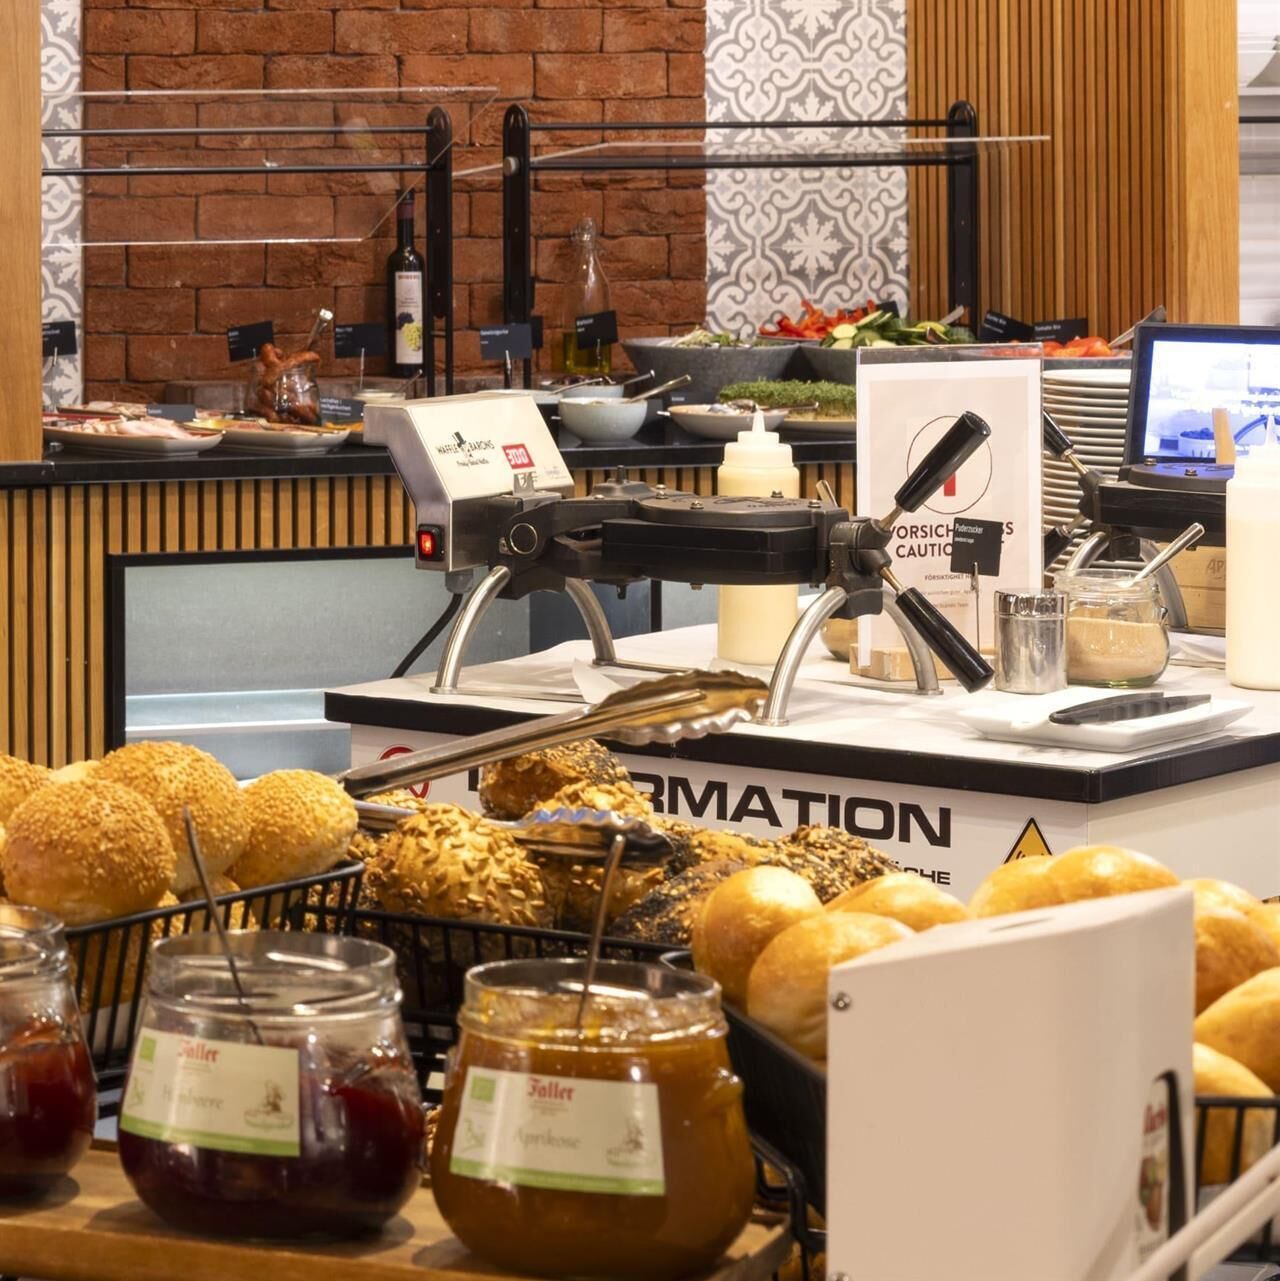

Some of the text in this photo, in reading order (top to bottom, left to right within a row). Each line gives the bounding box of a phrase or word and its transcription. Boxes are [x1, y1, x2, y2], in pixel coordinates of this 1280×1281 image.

[437, 440, 495, 455] WAFFLE BARONS
[890, 524, 954, 540] VORSICH
[954, 523, 984, 535] Puderzucker
[895, 542, 953, 559] CAUTIO
[468, 767, 952, 848] IRMATION
